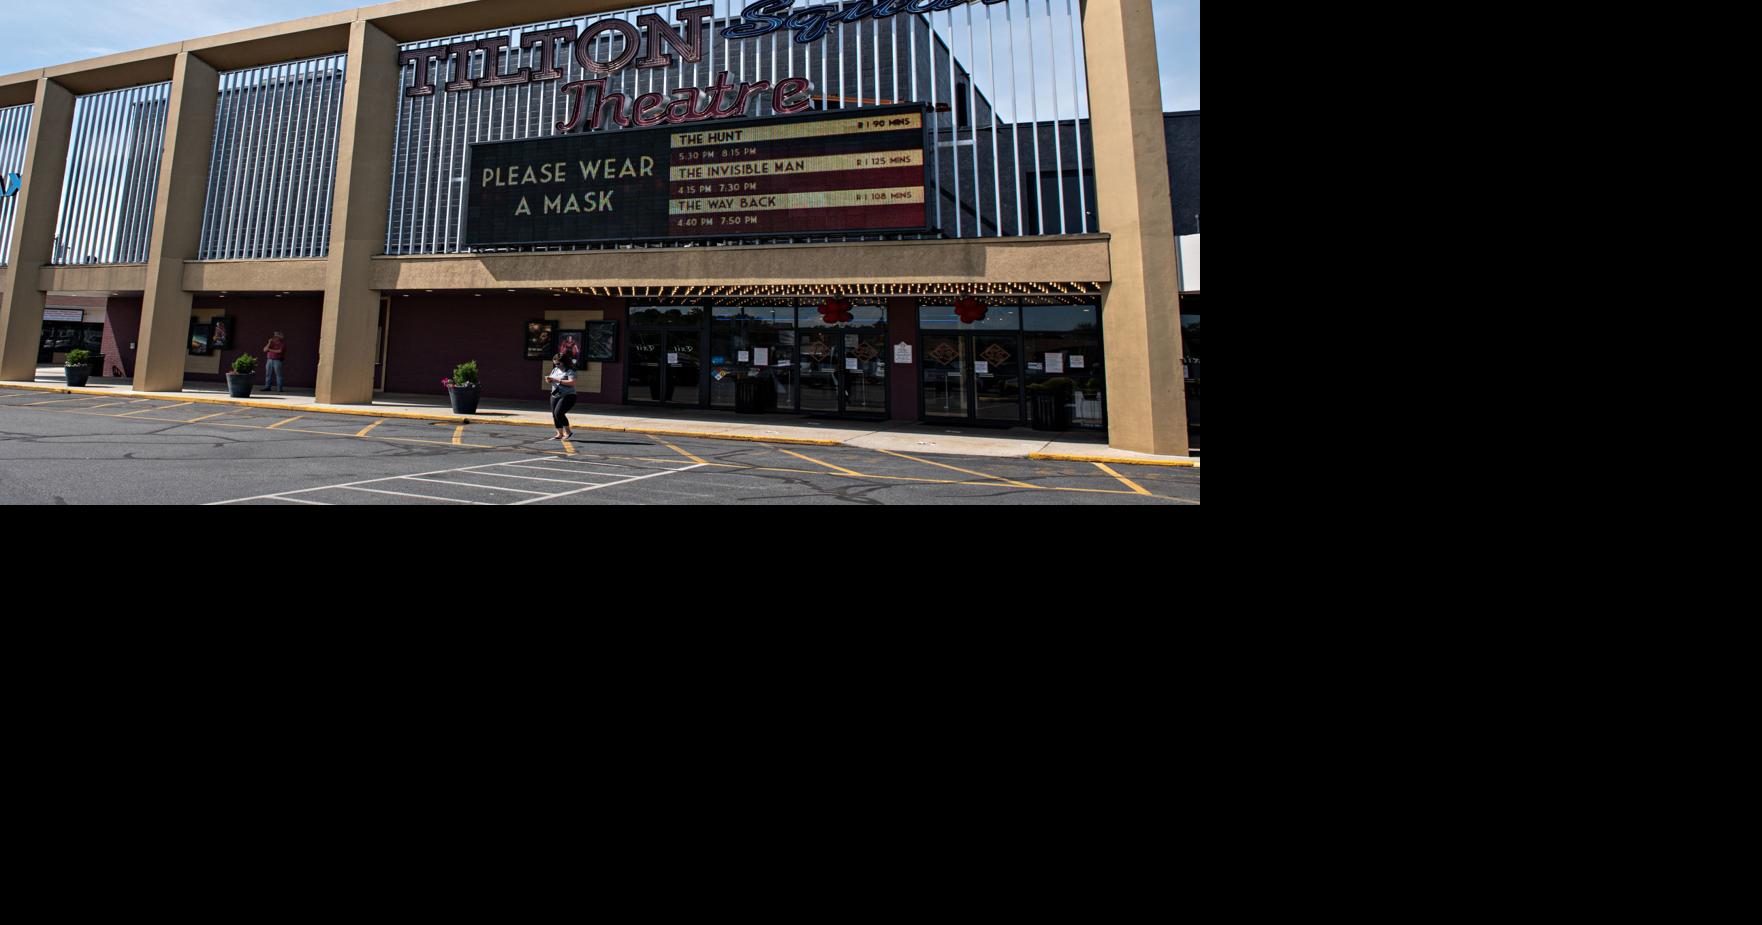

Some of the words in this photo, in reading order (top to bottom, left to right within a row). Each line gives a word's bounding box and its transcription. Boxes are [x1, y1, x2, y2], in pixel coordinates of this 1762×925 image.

[399, 4, 713, 98] TILTON
[556, 71, 814, 133] Theatre
[873, 119, 885, 127] 90
[680, 135, 703, 145] THE
[708, 131, 743, 142] HUNT
[702, 150, 714, 158] PM
[744, 147, 757, 155] PM
[872, 157, 886, 165] 125
[890, 155, 911, 163] MINS
[482, 162, 567, 188] PLEASE
[579, 155, 654, 180] WEAR
[679, 167, 702, 178] THE
[707, 163, 768, 175] INVISIBLE
[774, 160, 804, 172] MAN
[700, 184, 712, 192] PM
[744, 183, 757, 191] PM
[872, 192, 887, 200] 108
[891, 191, 912, 199] MINS
[514, 195, 531, 216] A
[543, 190, 614, 215] MASK
[678, 201, 702, 211] THE
[708, 199, 733, 210] WAY
[740, 196, 776, 208] BACK
[701, 218, 713, 226] PM
[745, 216, 757, 224] PM
